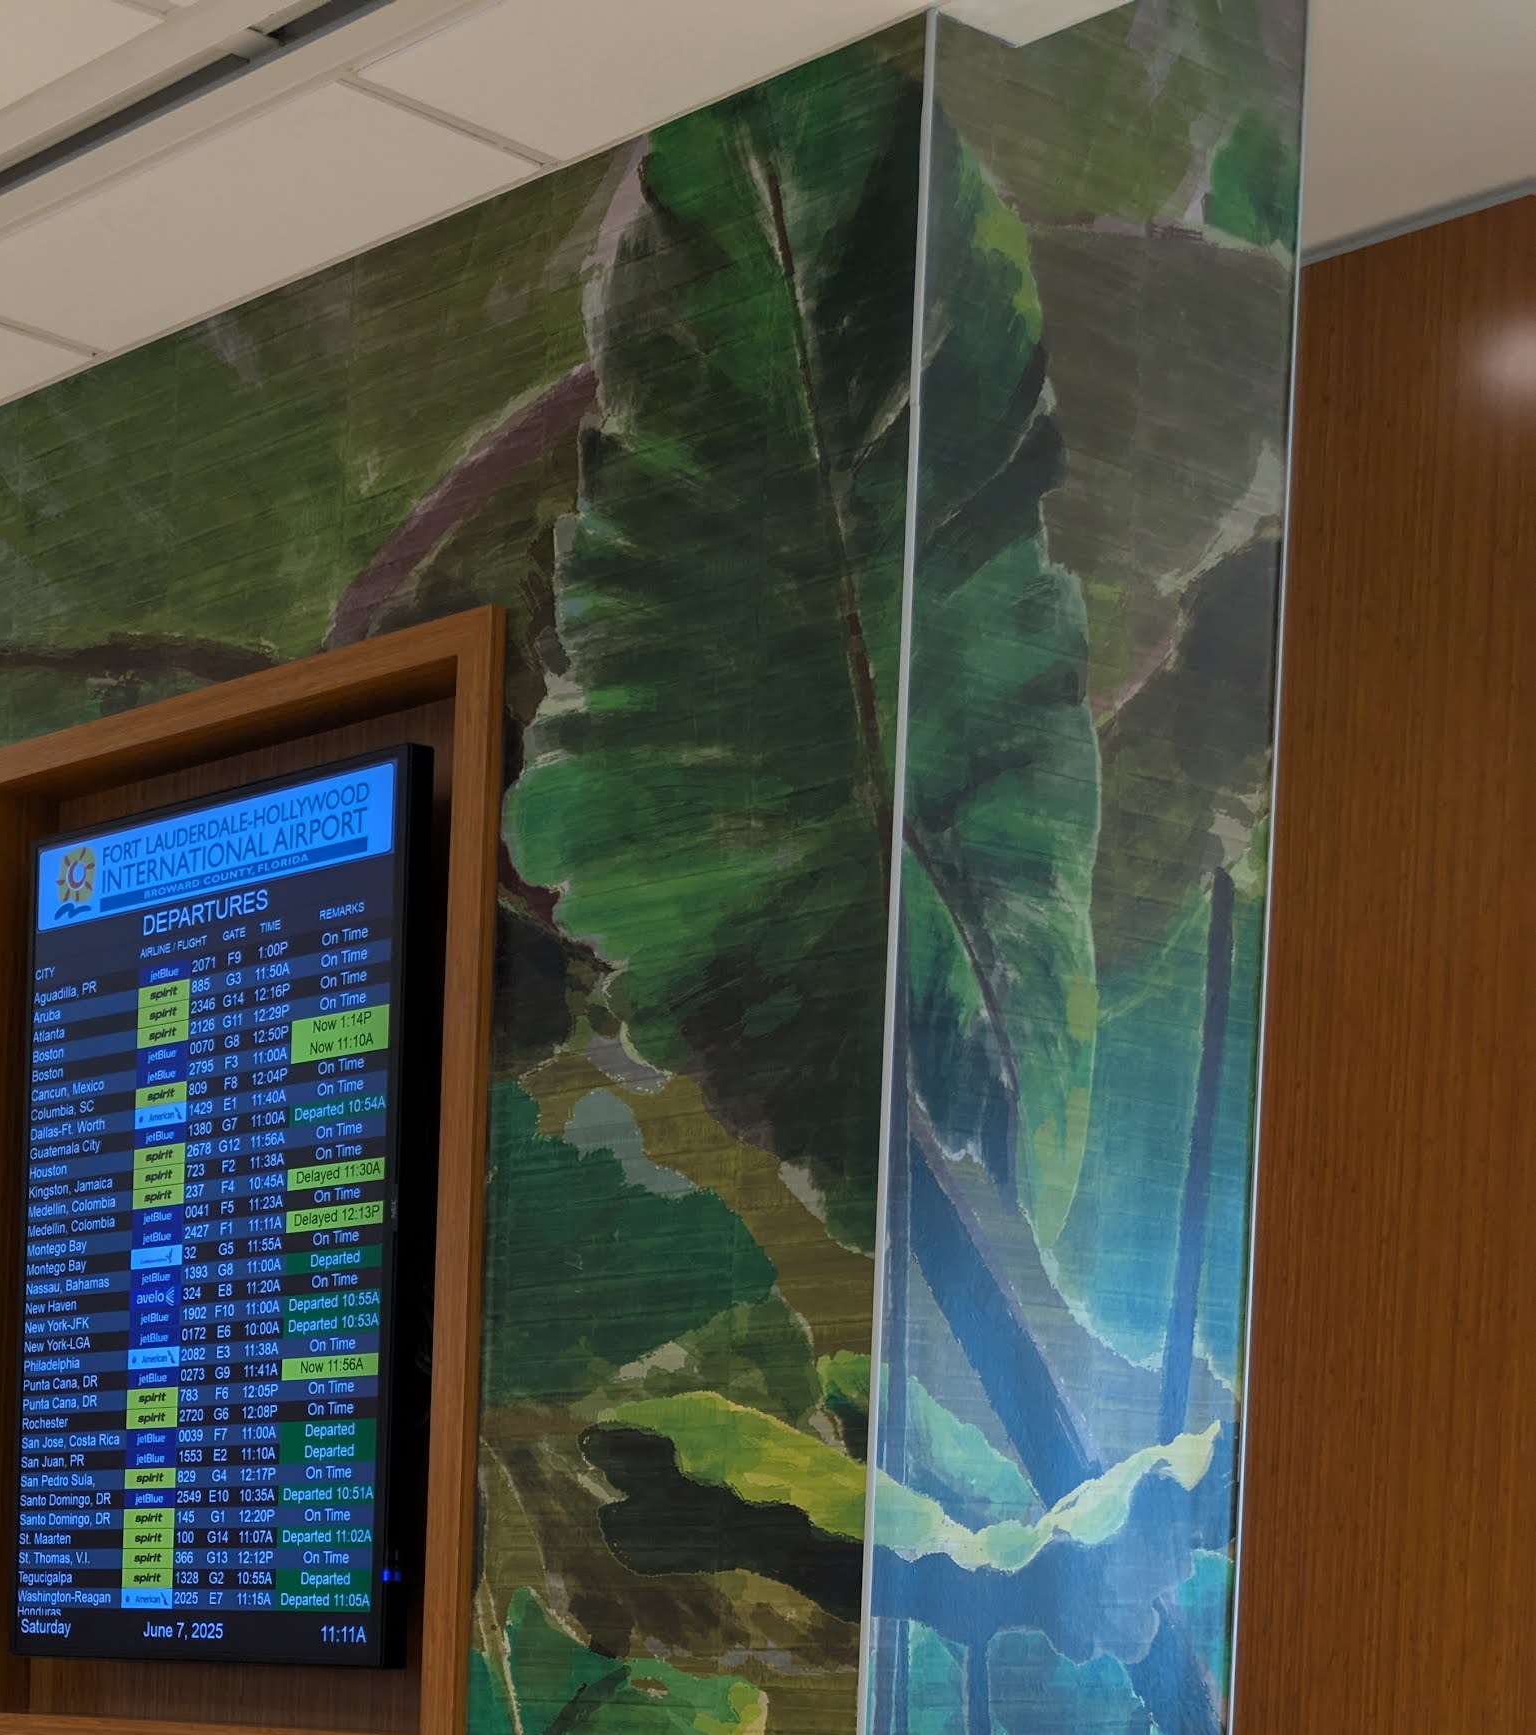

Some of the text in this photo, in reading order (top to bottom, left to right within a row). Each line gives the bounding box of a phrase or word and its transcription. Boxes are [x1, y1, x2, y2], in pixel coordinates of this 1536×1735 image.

[103, 781, 370, 866] FORT LAUDERDALE-HOLLYWOOD
[102, 806, 368, 894] INTERNATIONAL AIRPORT
[144, 853, 309, 899] BROWARD COUNTY, FLORIDA
[143, 889, 268, 936] DEPARTURES
[35, 966, 55, 981] CITY
[140, 942, 171, 958] AIRLINE
[177, 934, 208, 951] FLIGHT
[222, 927, 246, 941] GATE
[259, 919, 281, 933] TIME
[319, 901, 365, 920] REMARKS
[34, 927, 369, 1005] Aguadilla, PR jetBlue 2071 F9 1:00P On Time
[33, 970, 367, 1043] Atlanta spirit 2346 G14 12:16P On Time
[31, 1032, 374, 1102] Cancun, Mexico jetBlue 2795 F3 11:00A Now 11:10A
[30, 1095, 386, 1160] Guatemala City jetBlue 1380 G7 11:00A Departed 10:54A
[31, 1123, 74, 1141] Dallas-Ft.
[77, 1118, 105, 1134] Worth
[189, 1100, 213, 1116] 1429
[223, 1097, 237, 1111] E1
[252, 1089, 286, 1106] 11:40A
[317, 1082, 334, 1096] On
[337, 1079, 364, 1093] Time
[28, 1161, 381, 1218] Medellin, Colombia spirit 237 F4 10:45A Delayed 11:30A
[27, 1204, 380, 1257] Montego Bay jetBlue 2427 F1 11:11A Delayed 12:13P
[25, 1272, 358, 1315] New Haven avelo 324 E8 11:20A On Time
[26, 1250, 361, 1295] Nassau, Bahamas jetBlue 1393 G8 11:00A Departed
[25, 1291, 380, 1334] New York-JFK jetBlue 1902 F10 11:00A Departed 10:55A
[23, 1357, 364, 1392] Punta Cana, DR jetBlue 0273 G9 11:41A Now 11:56A
[22, 1422, 355, 1449] San Jose, Costa Rica jetBlue 0039 F7 11:00A Departed
[20, 1486, 374, 1509] Santo Domingo, DR jetBlue 2549 E10 10:35A Departed 10:51A
[19, 1550, 349, 1566] St. Thomas, V.I. spirit 366 G13 12:12P On Time
[18, 1590, 111, 1606] Washington-Reagan
[174, 1591, 198, 1604] 2025
[209, 1592, 223, 1605] E7
[237, 1592, 271, 1605] 11:15A
[280, 1592, 330, 1609] Departed
[334, 1593, 370, 1607] 11:05A
[21, 1618, 366, 1643] Saturday June 7, 2025 11:11A
